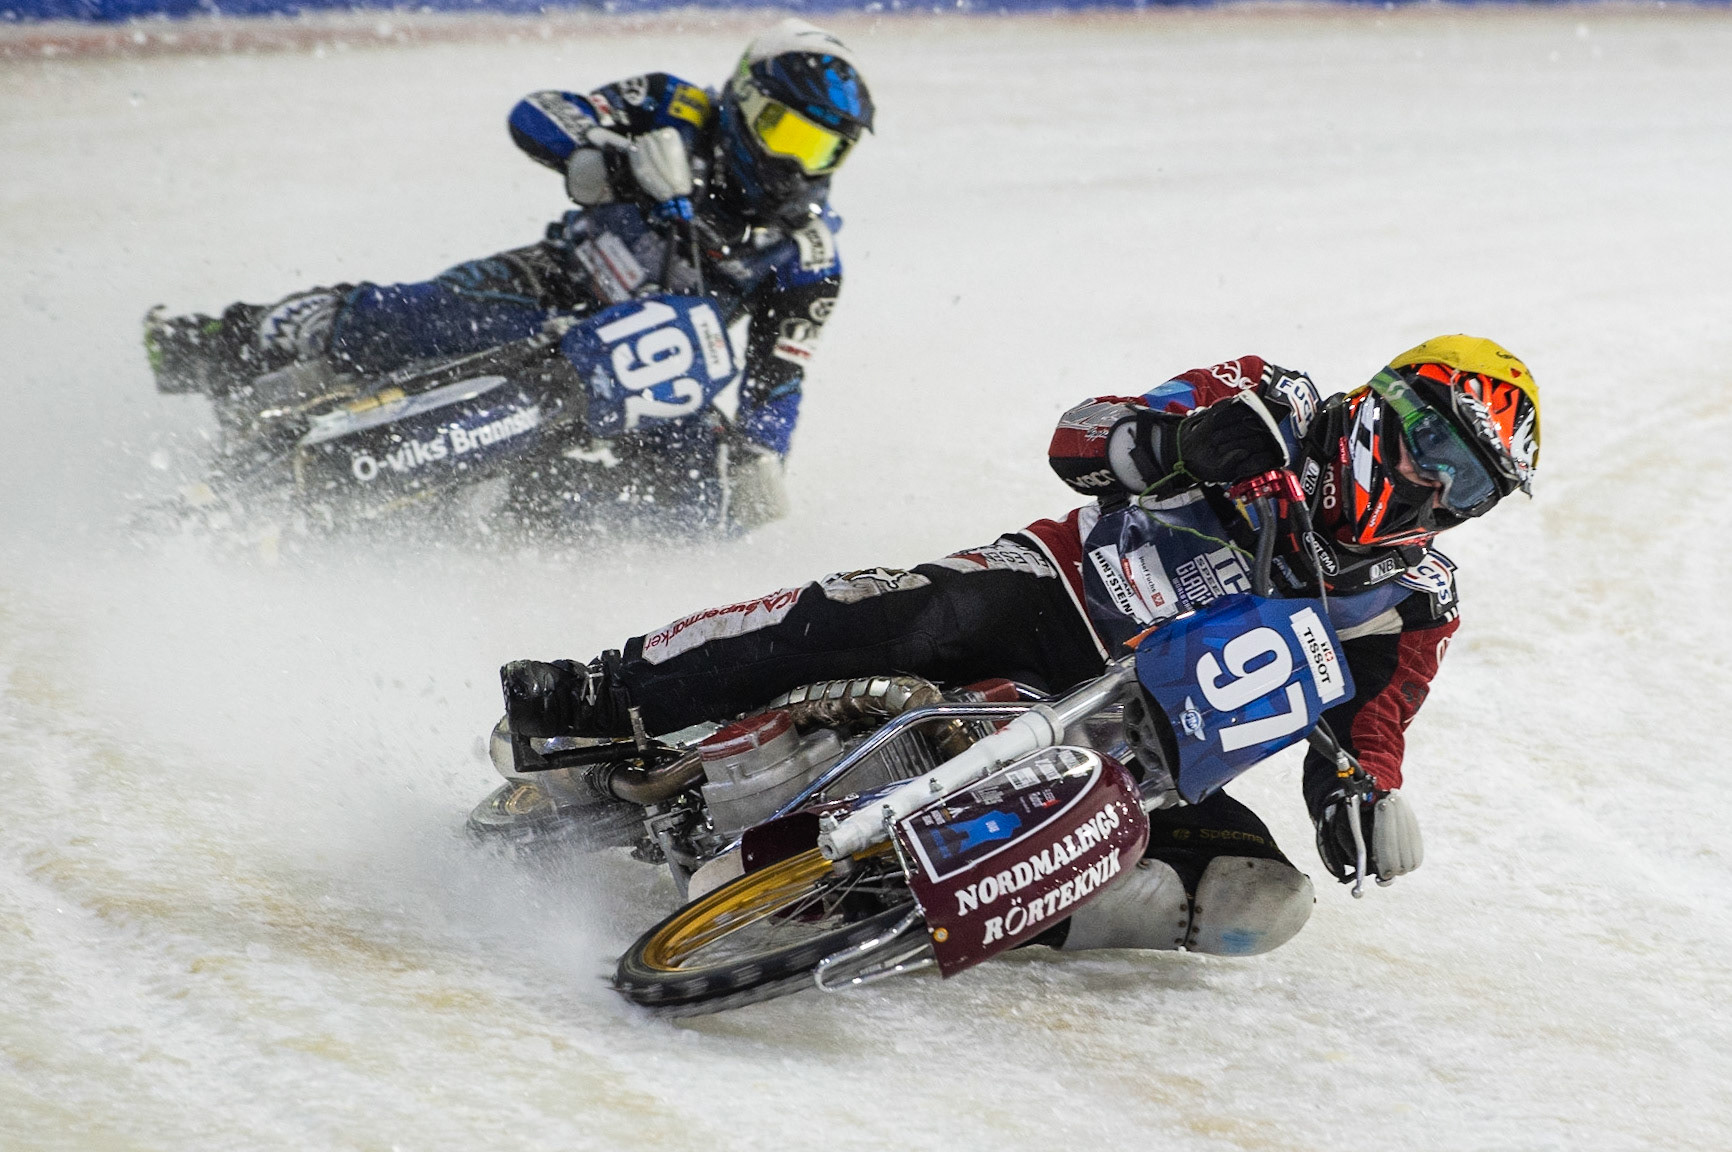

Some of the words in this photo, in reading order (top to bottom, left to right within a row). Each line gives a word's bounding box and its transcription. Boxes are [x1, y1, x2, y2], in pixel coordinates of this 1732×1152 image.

[596, 301, 703, 428] 192
[1416, 564, 1450, 601] CHS
[1195, 626, 1309, 753] 97
[1303, 626, 1332, 684] TISSOT
[954, 803, 1121, 917] NORDMALINGS
[1199, 828, 1265, 845] Specma
[982, 847, 1122, 945] RÖRTEKNIK
